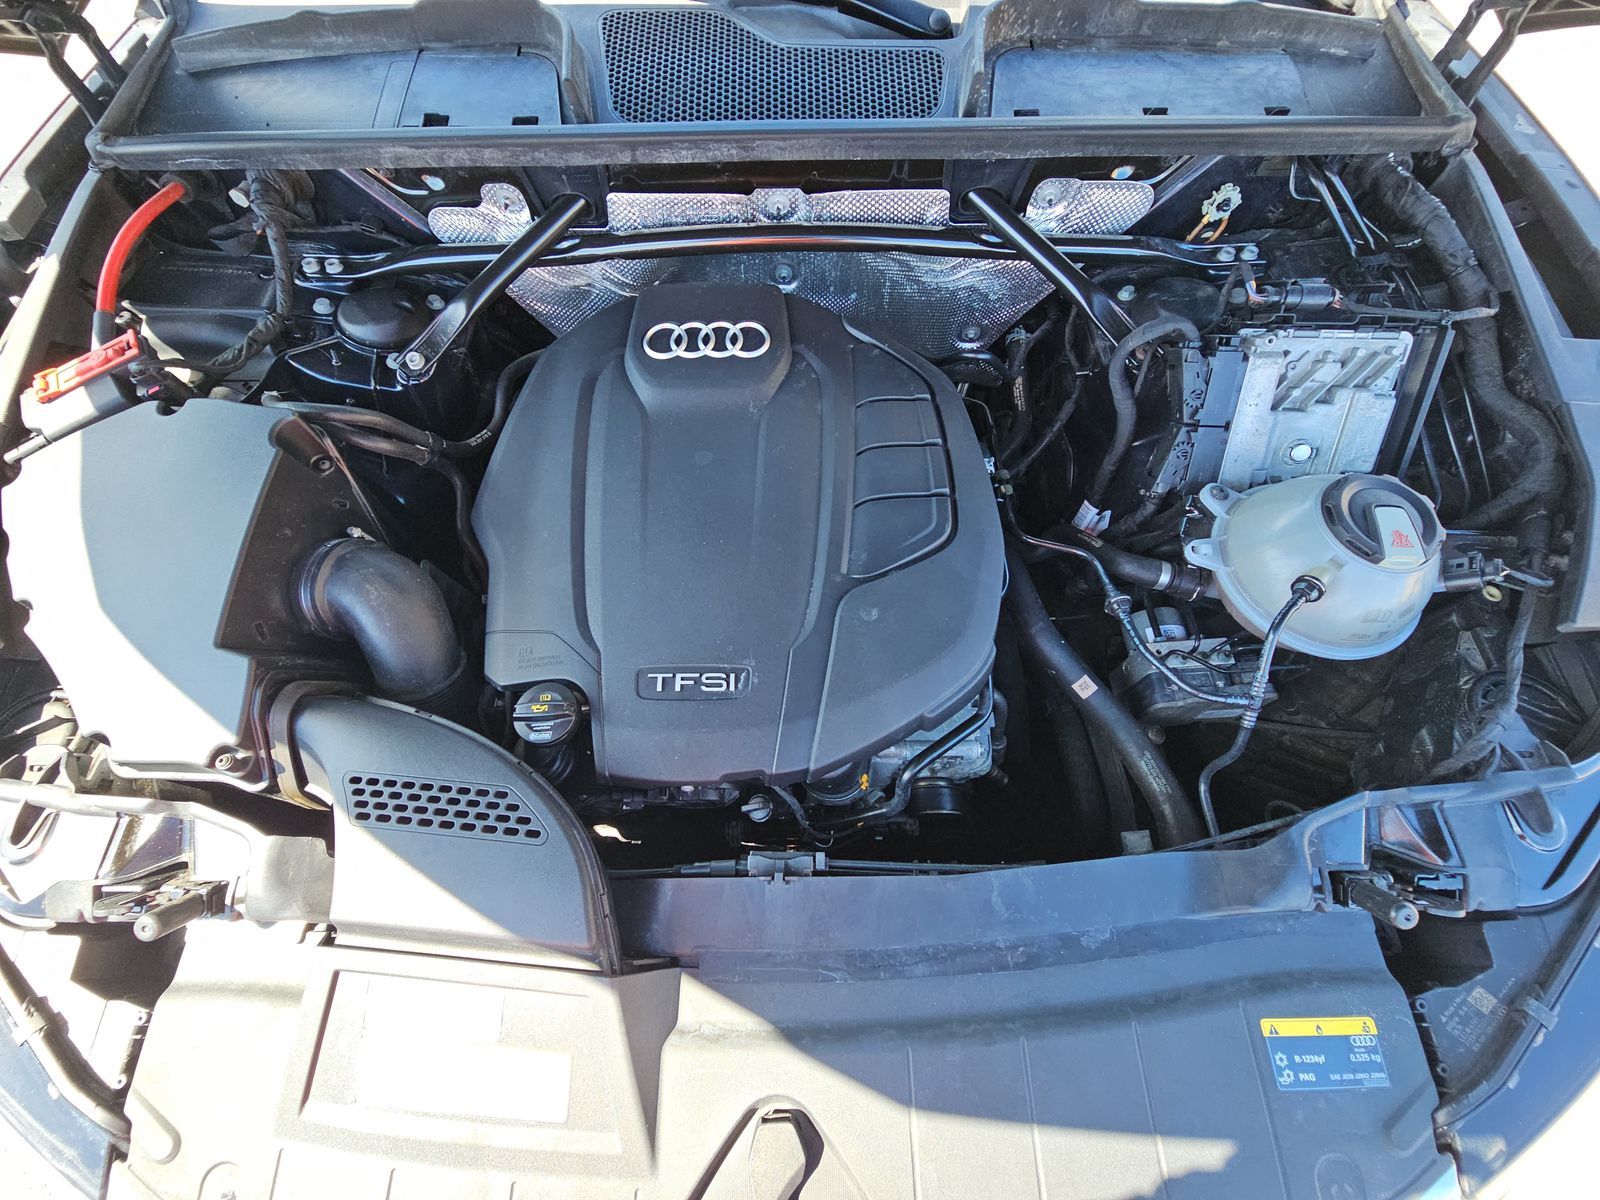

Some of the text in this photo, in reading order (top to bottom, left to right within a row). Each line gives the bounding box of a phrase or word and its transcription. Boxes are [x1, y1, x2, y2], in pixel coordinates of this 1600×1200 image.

[647, 673, 736, 692] TFSI
[1294, 1054, 1326, 1065] R-1234yf
[1370, 1053, 1382, 1063] kg
[1298, 1073, 1316, 1082] PAG
